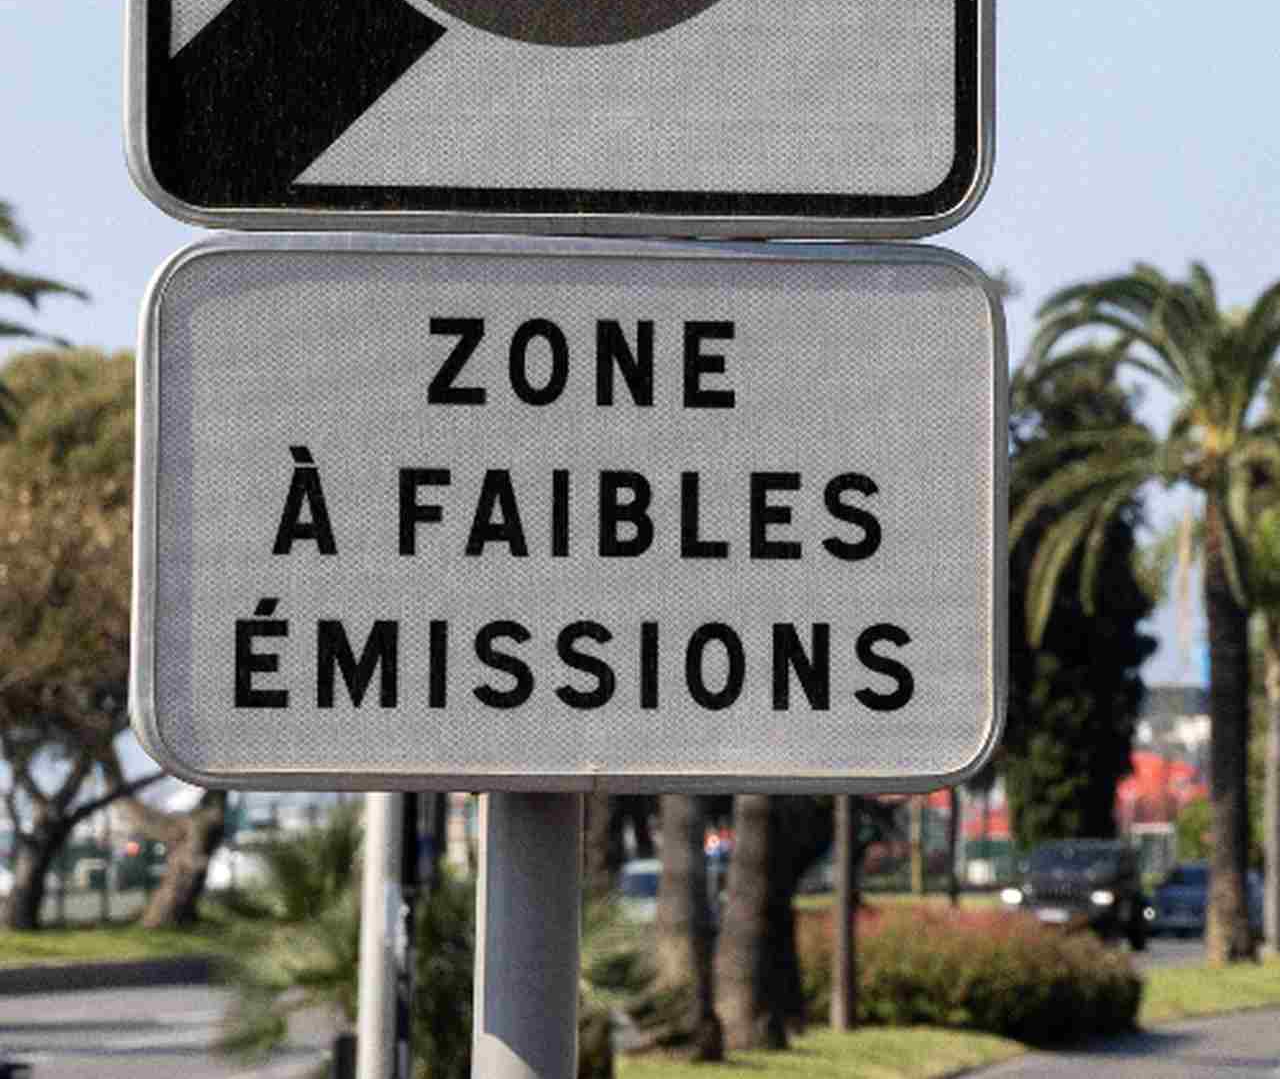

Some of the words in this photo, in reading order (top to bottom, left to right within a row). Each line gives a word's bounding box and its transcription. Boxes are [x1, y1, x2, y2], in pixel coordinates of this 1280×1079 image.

[426, 316, 736, 410] ZONE
[271, 445, 339, 556] À
[398, 466, 883, 563] FAIBLES
[233, 597, 915, 713] ÉMISSIONS
